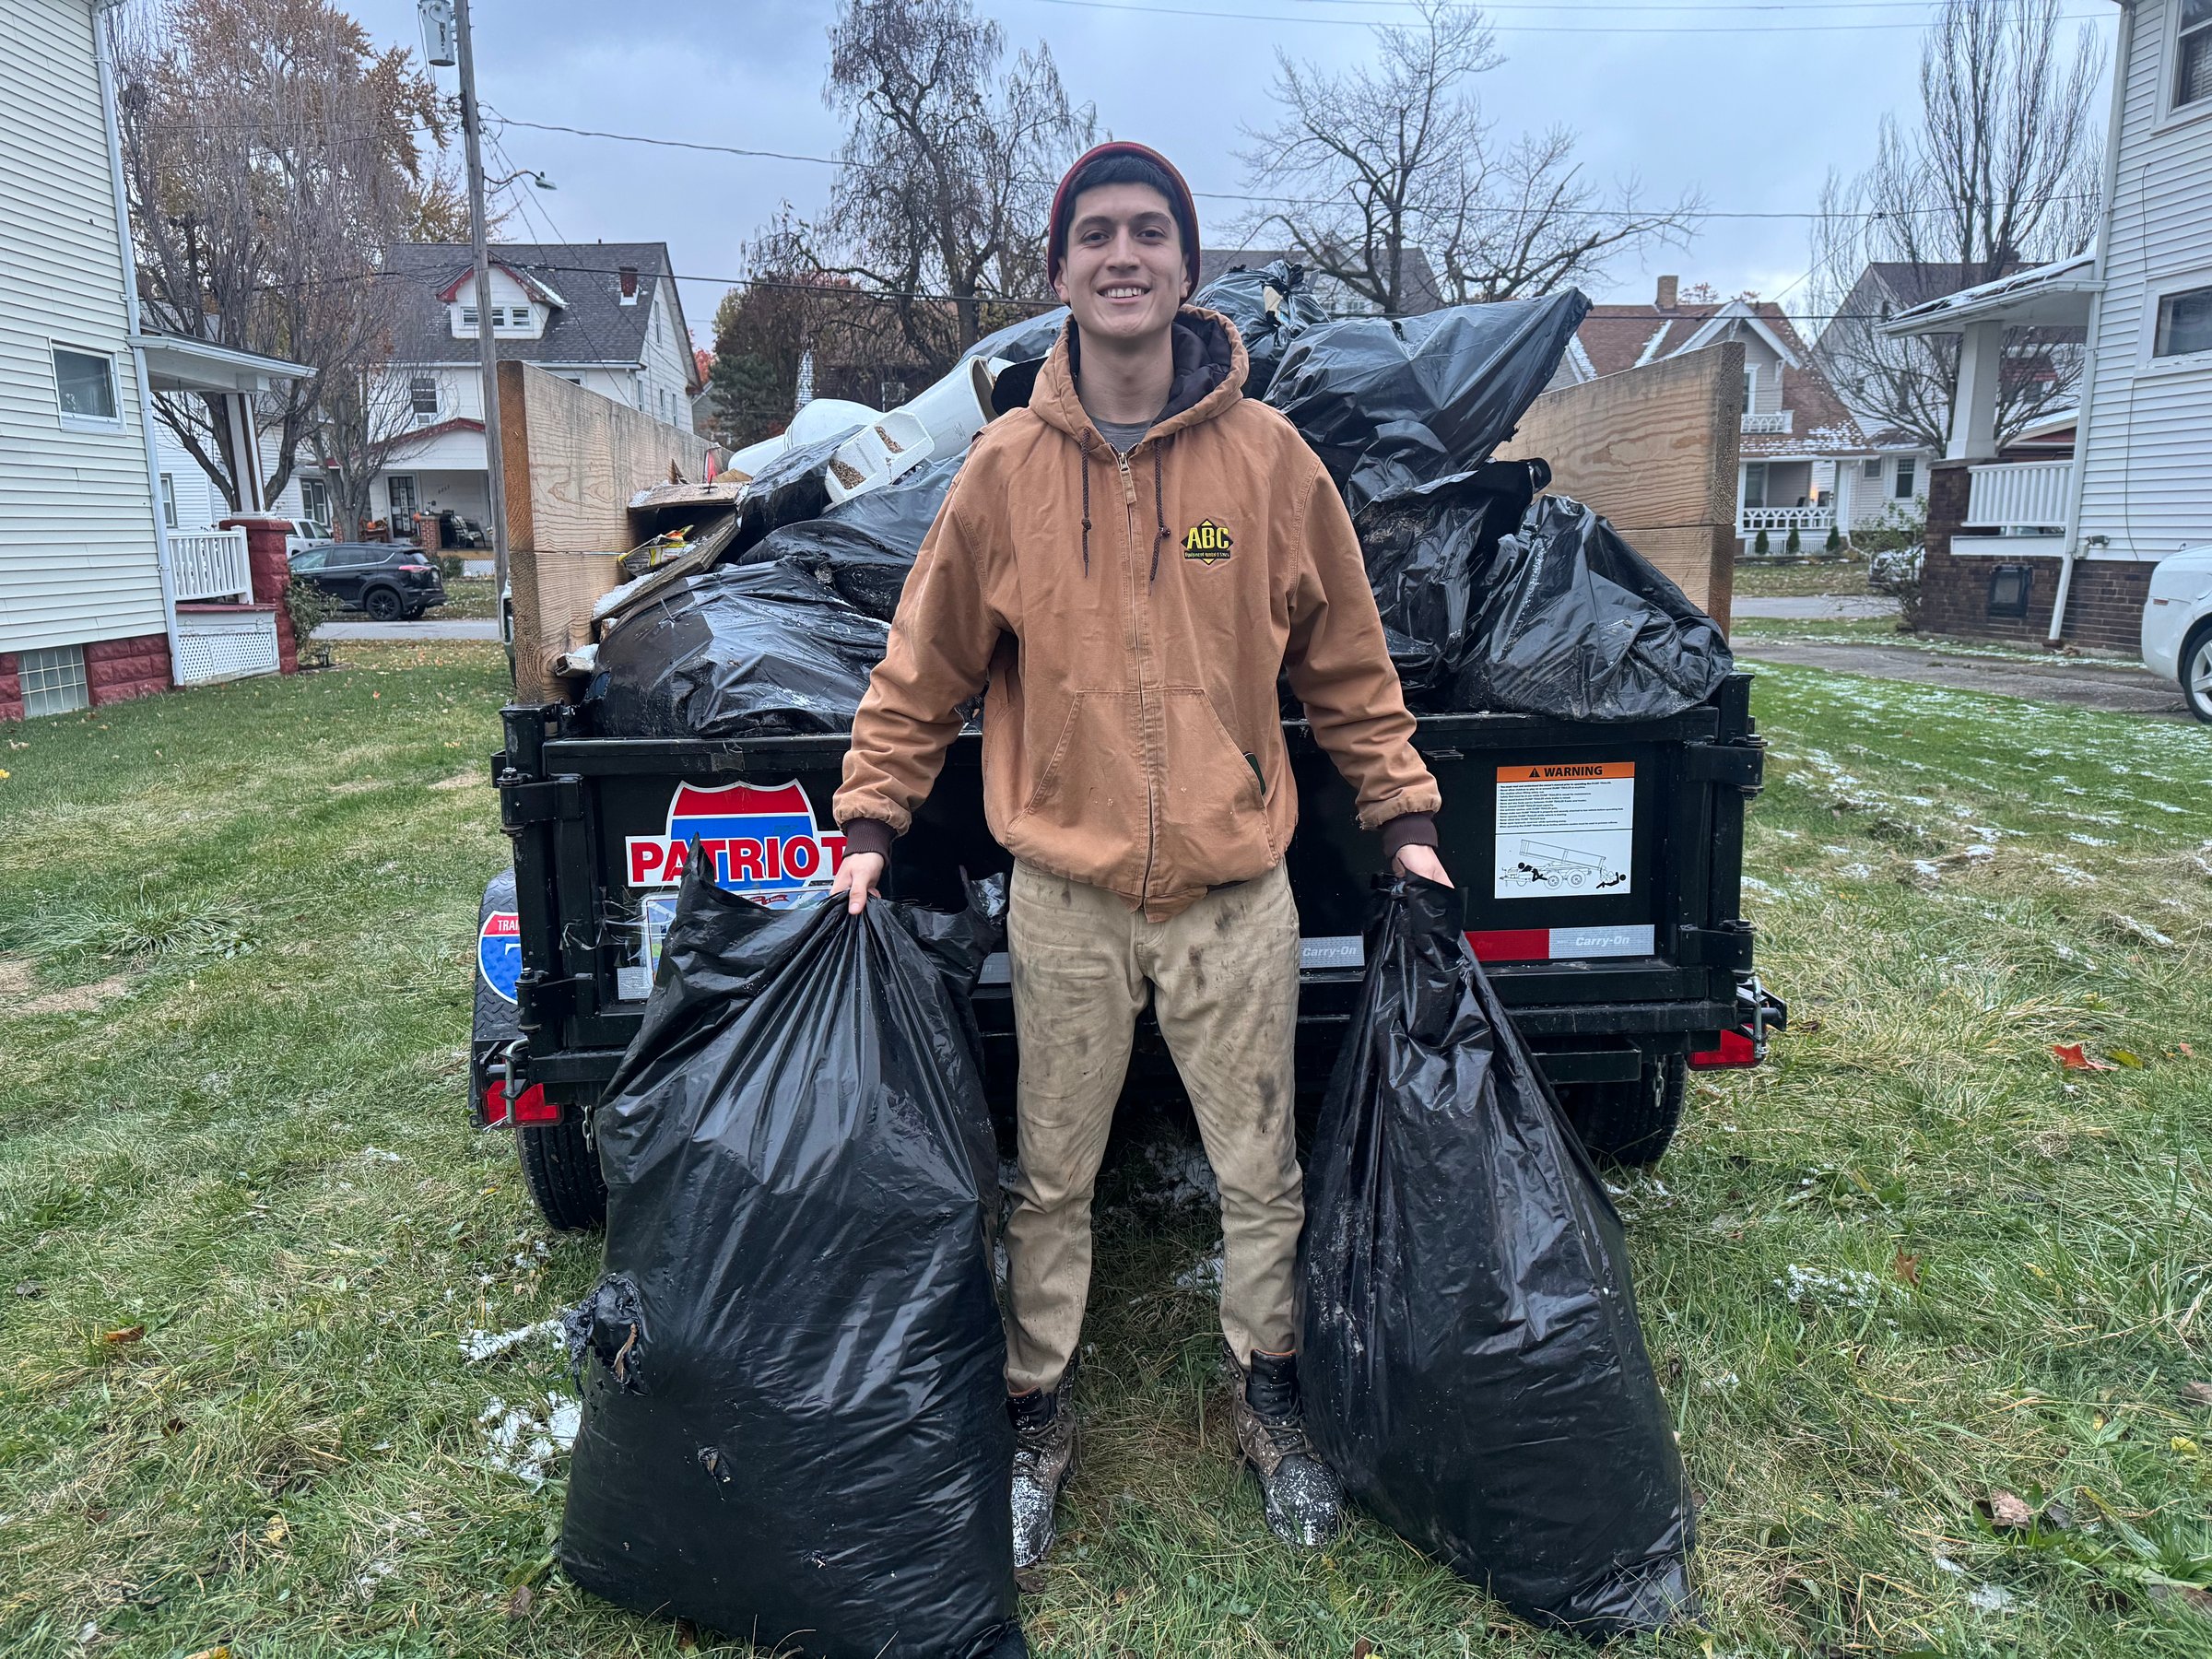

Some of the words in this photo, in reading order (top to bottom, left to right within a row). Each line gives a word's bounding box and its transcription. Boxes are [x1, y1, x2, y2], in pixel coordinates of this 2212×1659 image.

[1187, 527, 1229, 549] ABC
[1544, 766, 1603, 777] WARNING
[630, 835, 848, 883] PATRIOT
[498, 919, 520, 931] TRAI
[1575, 935, 1630, 947] Carry-On
[1302, 946, 1357, 958] Carry-On
